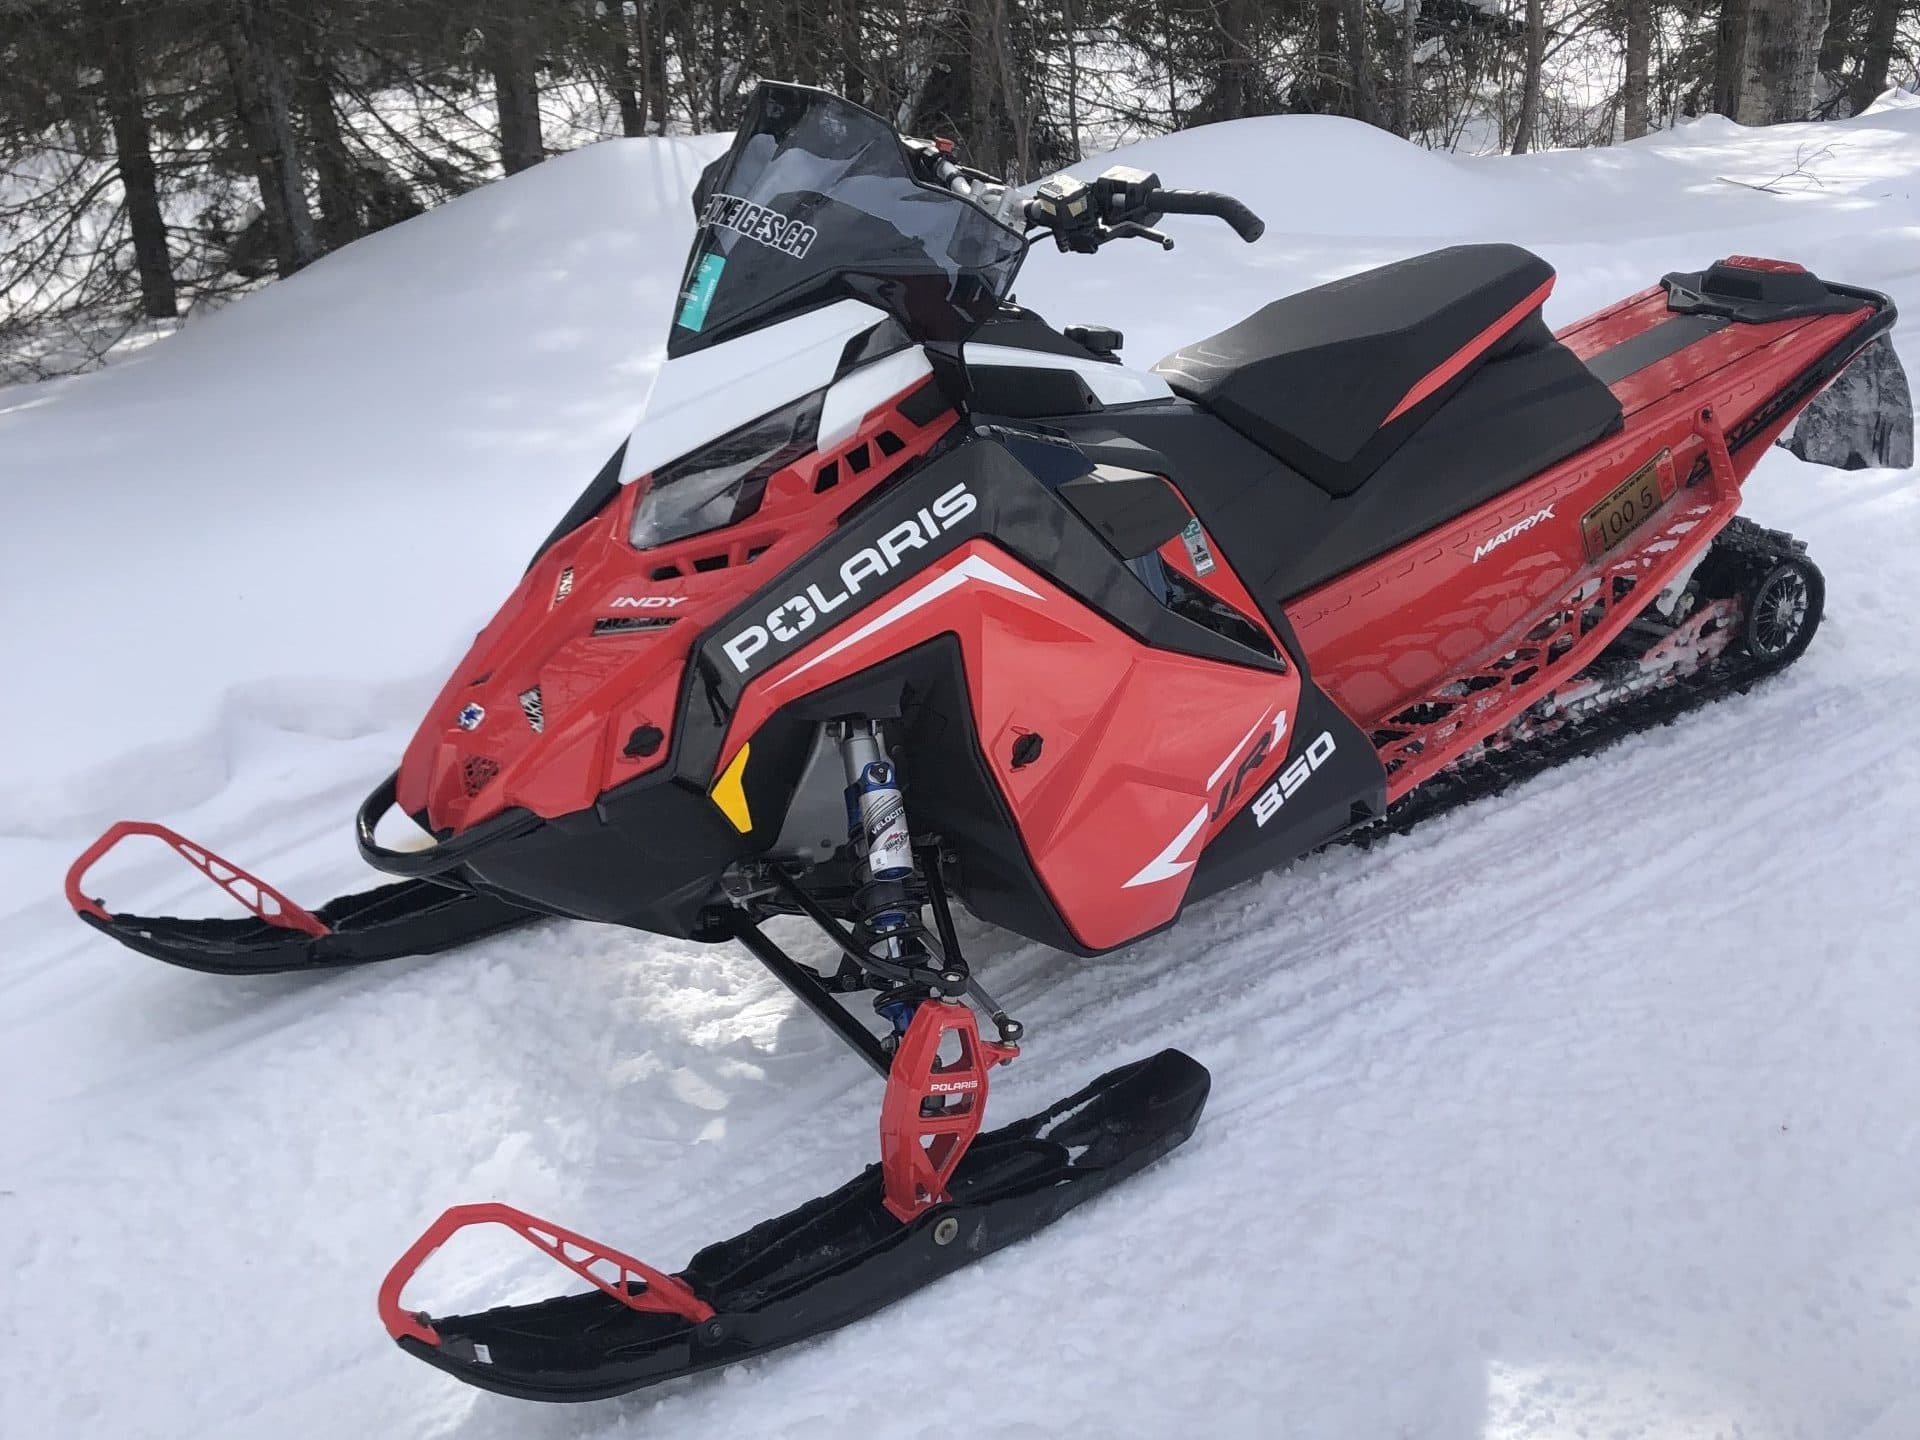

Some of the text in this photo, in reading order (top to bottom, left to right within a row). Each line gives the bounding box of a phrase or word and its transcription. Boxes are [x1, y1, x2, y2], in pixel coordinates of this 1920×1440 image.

[1472, 503, 1555, 564] MATRYX
[609, 596, 688, 608] INDY
[721, 482, 977, 673] POLARIS
[1251, 731, 1336, 828] 850
[930, 1080, 978, 1092] POLARIS
